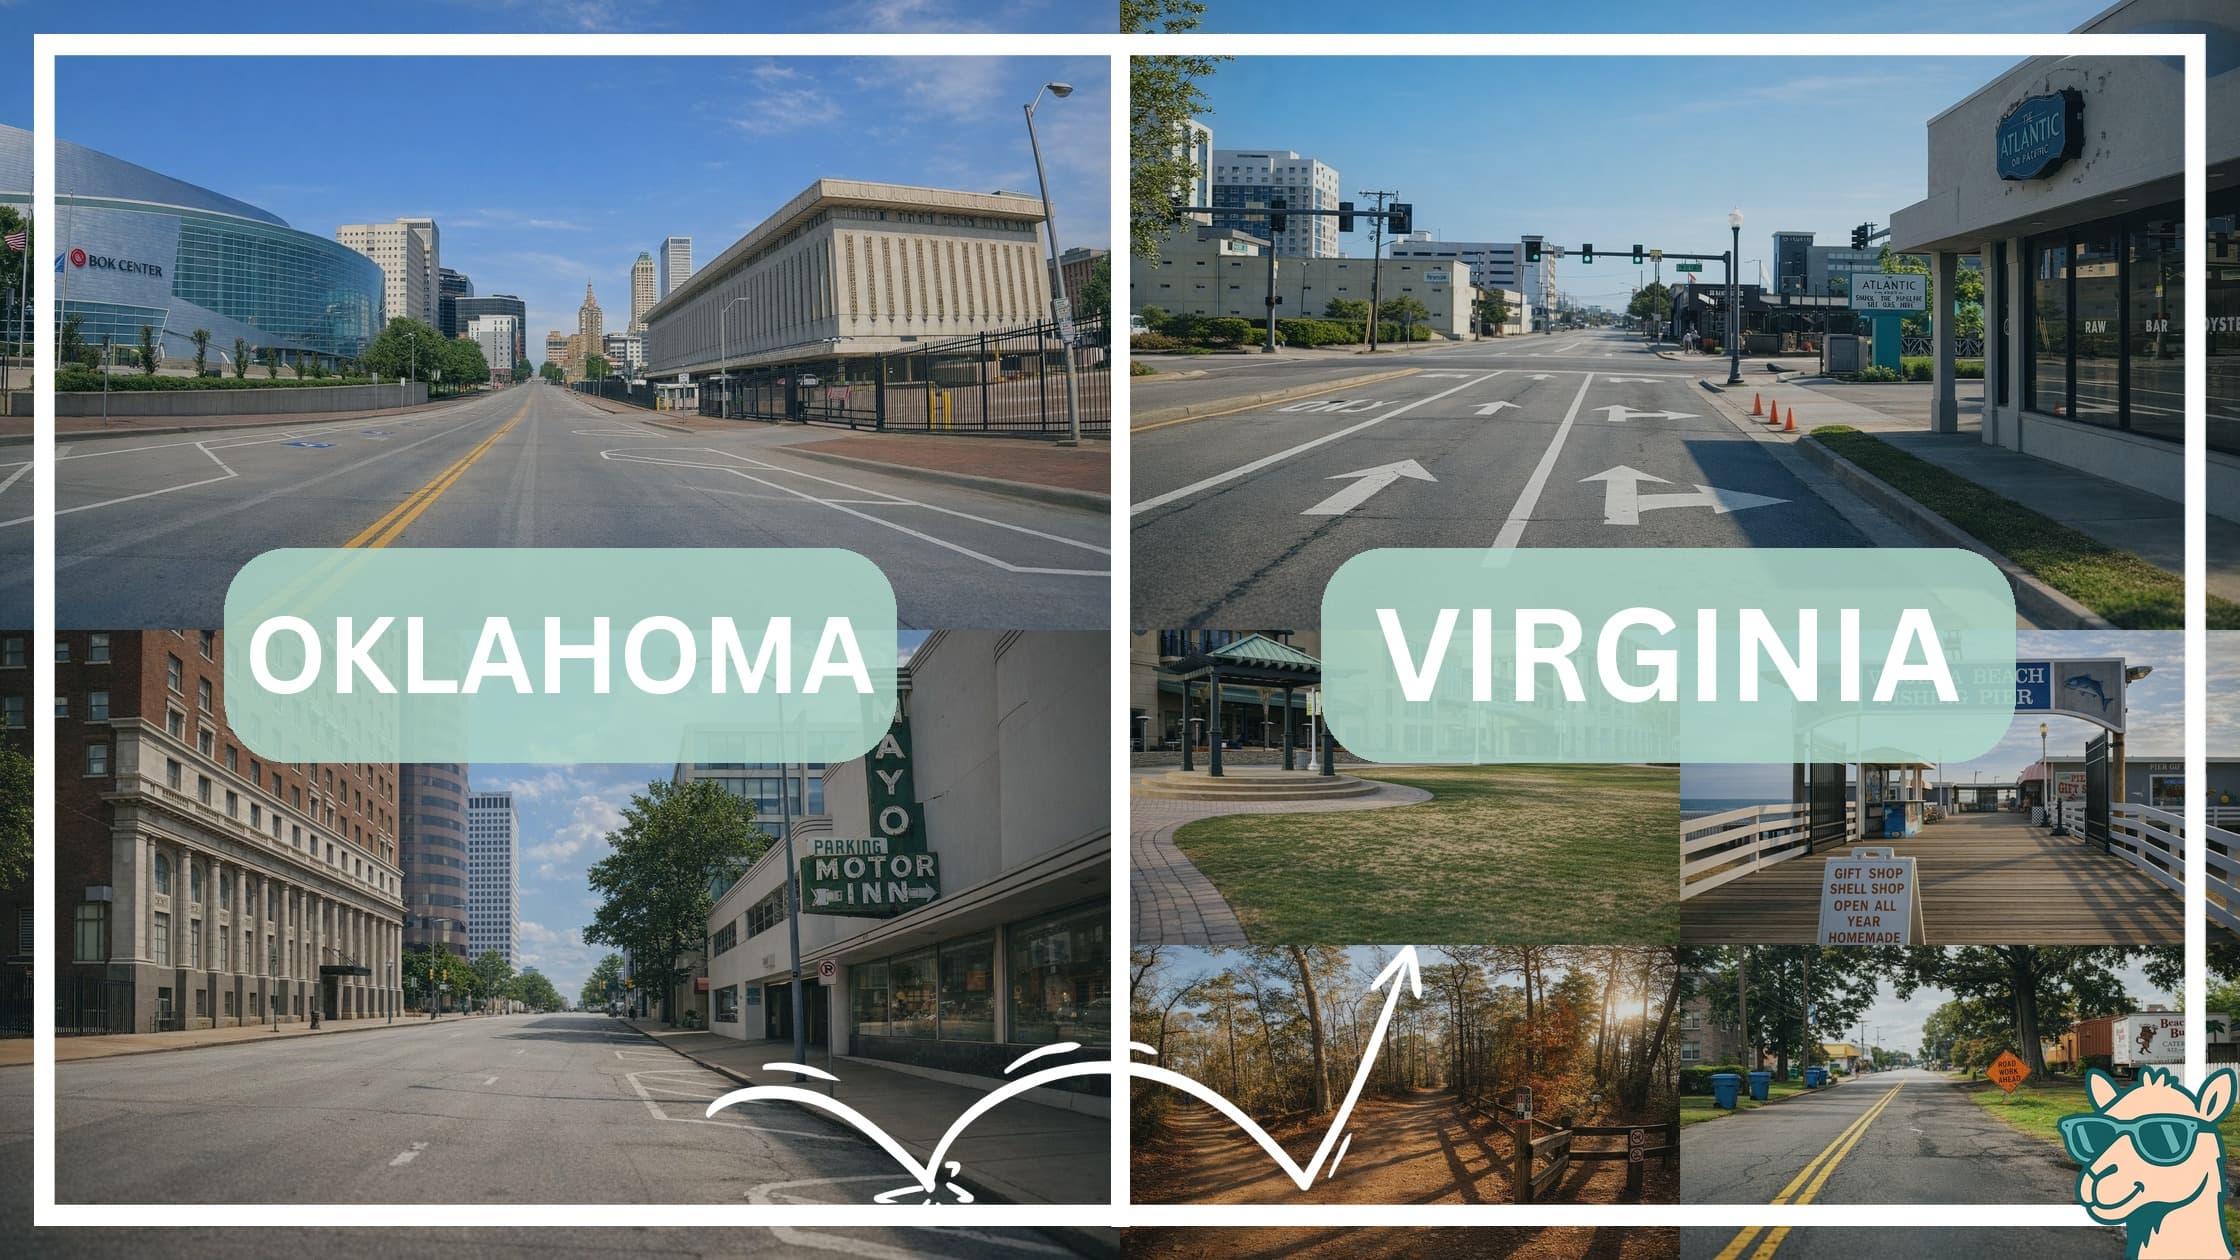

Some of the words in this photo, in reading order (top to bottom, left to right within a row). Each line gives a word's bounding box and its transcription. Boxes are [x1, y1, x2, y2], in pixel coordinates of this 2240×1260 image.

[2001, 112, 2060, 159] ATLANTIC
[89, 254, 116, 269] BOK
[118, 259, 163, 277] CENTER
[1862, 280, 1917, 290] ATLANTIC
[2085, 320, 2107, 334] RAW
[2145, 319, 2168, 333] BAR
[2058, 782, 2079, 794] GIFT
[814, 839, 881, 855] PARKING
[815, 855, 936, 881] MOTOR
[1834, 867, 1862, 880] GIFT
[1868, 867, 1904, 880] SHOP
[847, 881, 909, 905] INN
[1830, 883, 1867, 895] SHELL
[1871, 883, 1905, 895] SHOP
[1834, 900, 1869, 912] OPEN
[1874, 900, 1897, 912] ALL
[1847, 915, 1881, 928] YEAR
[1828, 932, 1901, 944] HOMEMADE
[2160, 1018, 2185, 1029] Beac
[2170, 1028, 2185, 1038] Bu
[1998, 1060, 2017, 1068] ROAD
[1999, 1068, 2018, 1076] WORK
[1999, 1075, 2021, 1083] AHEAD
